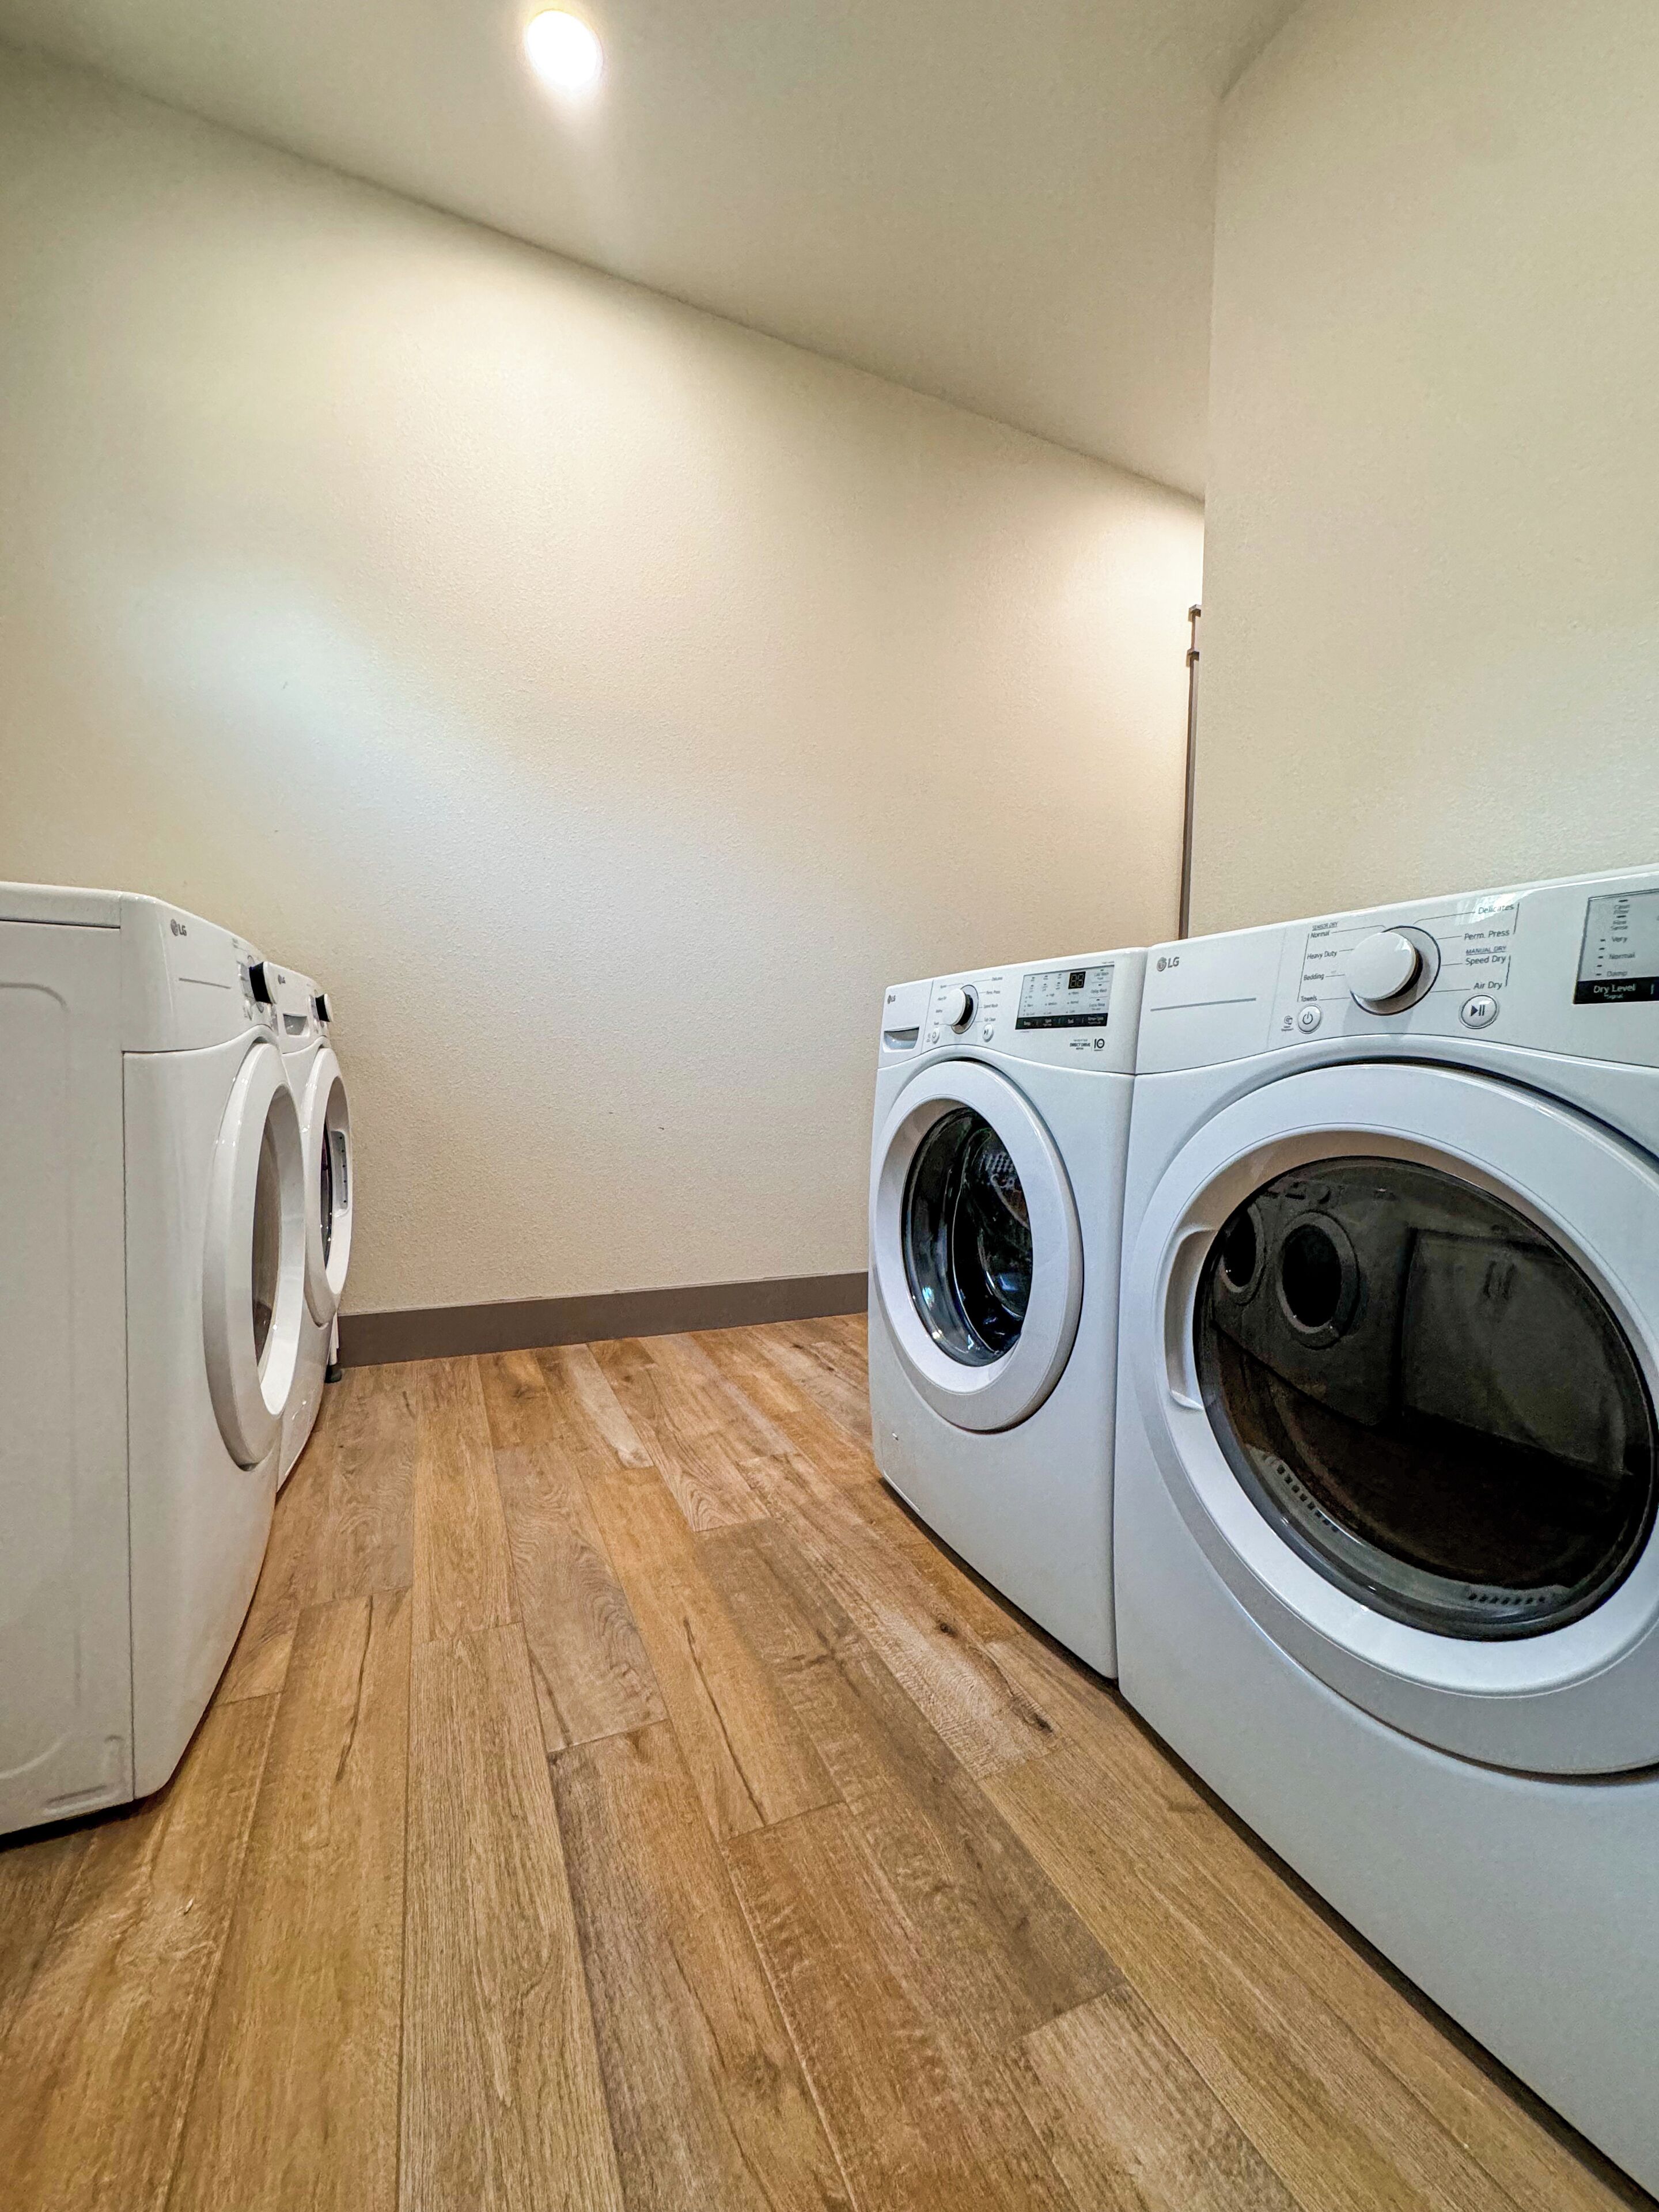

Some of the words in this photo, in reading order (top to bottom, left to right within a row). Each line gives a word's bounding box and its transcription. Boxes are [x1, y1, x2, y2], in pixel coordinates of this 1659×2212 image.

[1478, 904, 1515, 914] Delicates
[1310, 930, 1330, 938] Normal
[1488, 930, 1510, 938] Press
[1324, 950, 1338, 959] Duty
[1465, 956, 1490, 966] Speed
[1491, 955, 1506, 963] Dry
[1474, 982, 1486, 990] Air
[1487, 981, 1503, 990] Dry
[1593, 984, 1610, 995] Dry
[1611, 983, 1637, 993] Level
